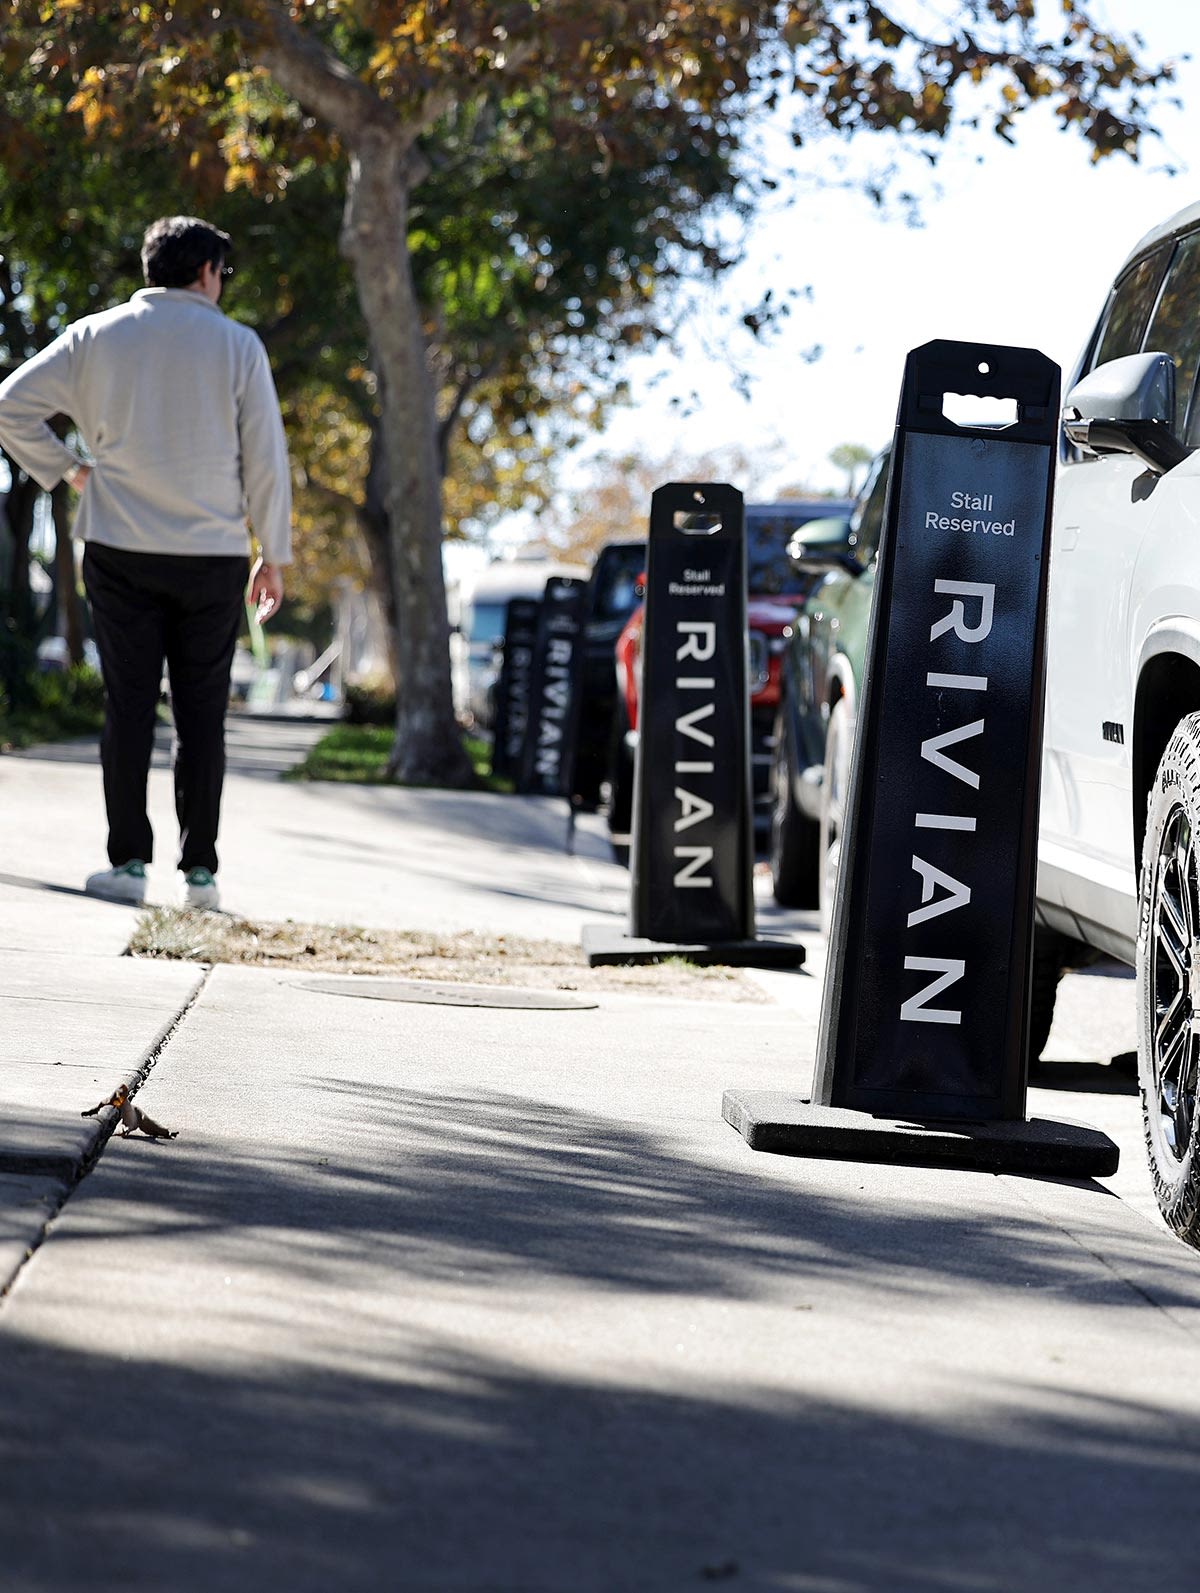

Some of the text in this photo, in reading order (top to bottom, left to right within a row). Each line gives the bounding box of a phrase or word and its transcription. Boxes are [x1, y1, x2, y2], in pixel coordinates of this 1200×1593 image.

[949, 491, 993, 512] Stall
[924, 511, 1016, 537] Reserved
[683, 569, 710, 582] Stall
[668, 582, 725, 597] Reserved
[535, 638, 573, 776] RIVIAN
[673, 620, 716, 888] RIVIAN
[899, 578, 996, 1026] RIVIAN
